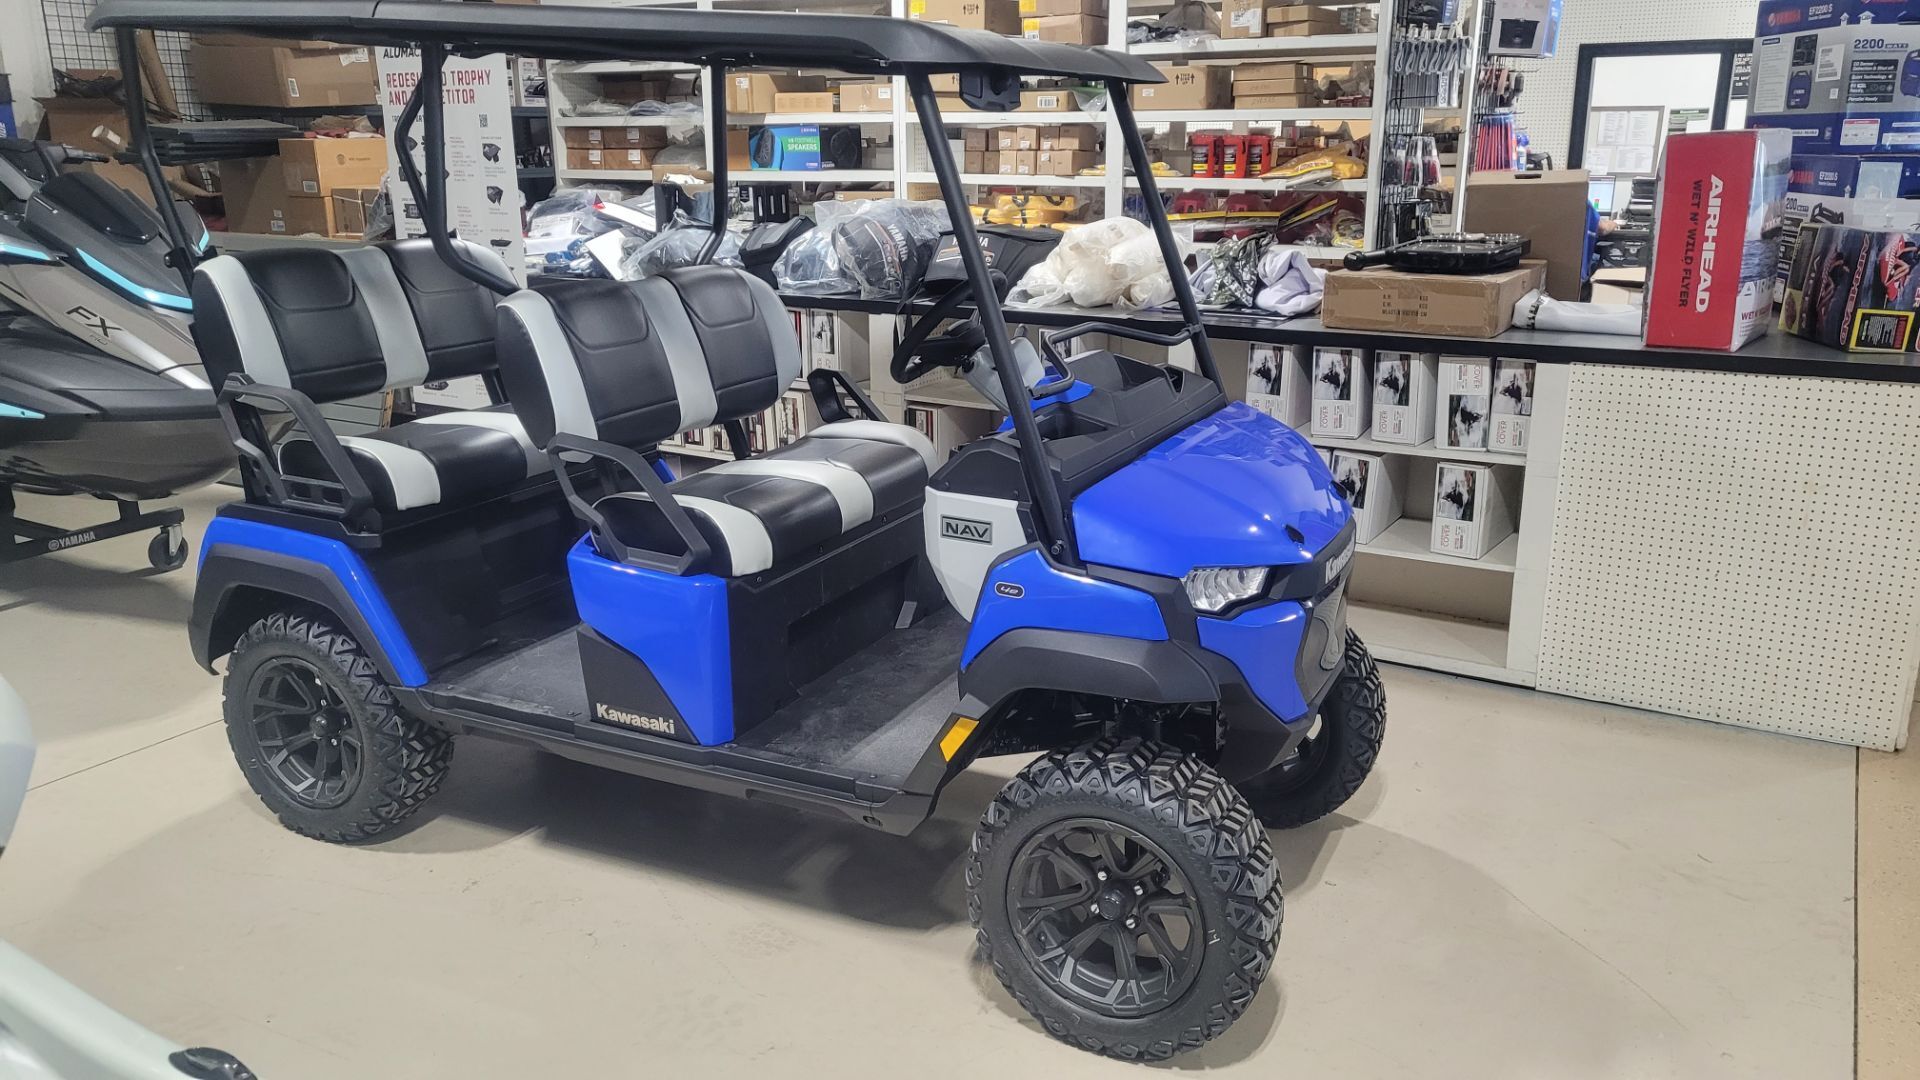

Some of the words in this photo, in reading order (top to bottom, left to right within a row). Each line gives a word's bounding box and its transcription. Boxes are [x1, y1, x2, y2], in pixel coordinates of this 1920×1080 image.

[383, 46, 422, 59] ALUMAC
[1853, 39, 1885, 50] 2200
[386, 70, 447, 88] REDESID
[451, 69, 491, 86] TROPHY
[388, 90, 408, 106] AND
[1691, 179, 1703, 209] WET
[887, 223, 909, 262] YAMAHA
[1681, 228, 1697, 265] WILD
[1695, 174, 1724, 313] AIRHEAD
[1679, 269, 1692, 308] FLYER
[1840, 233, 1870, 346] AIRHEAD
[66, 305, 123, 338] FX
[1499, 420, 1507, 445] COVER
[60, 531, 96, 548] YAMAHA
[945, 521, 989, 539] NAV
[596, 702, 675, 734] Kawasaki
